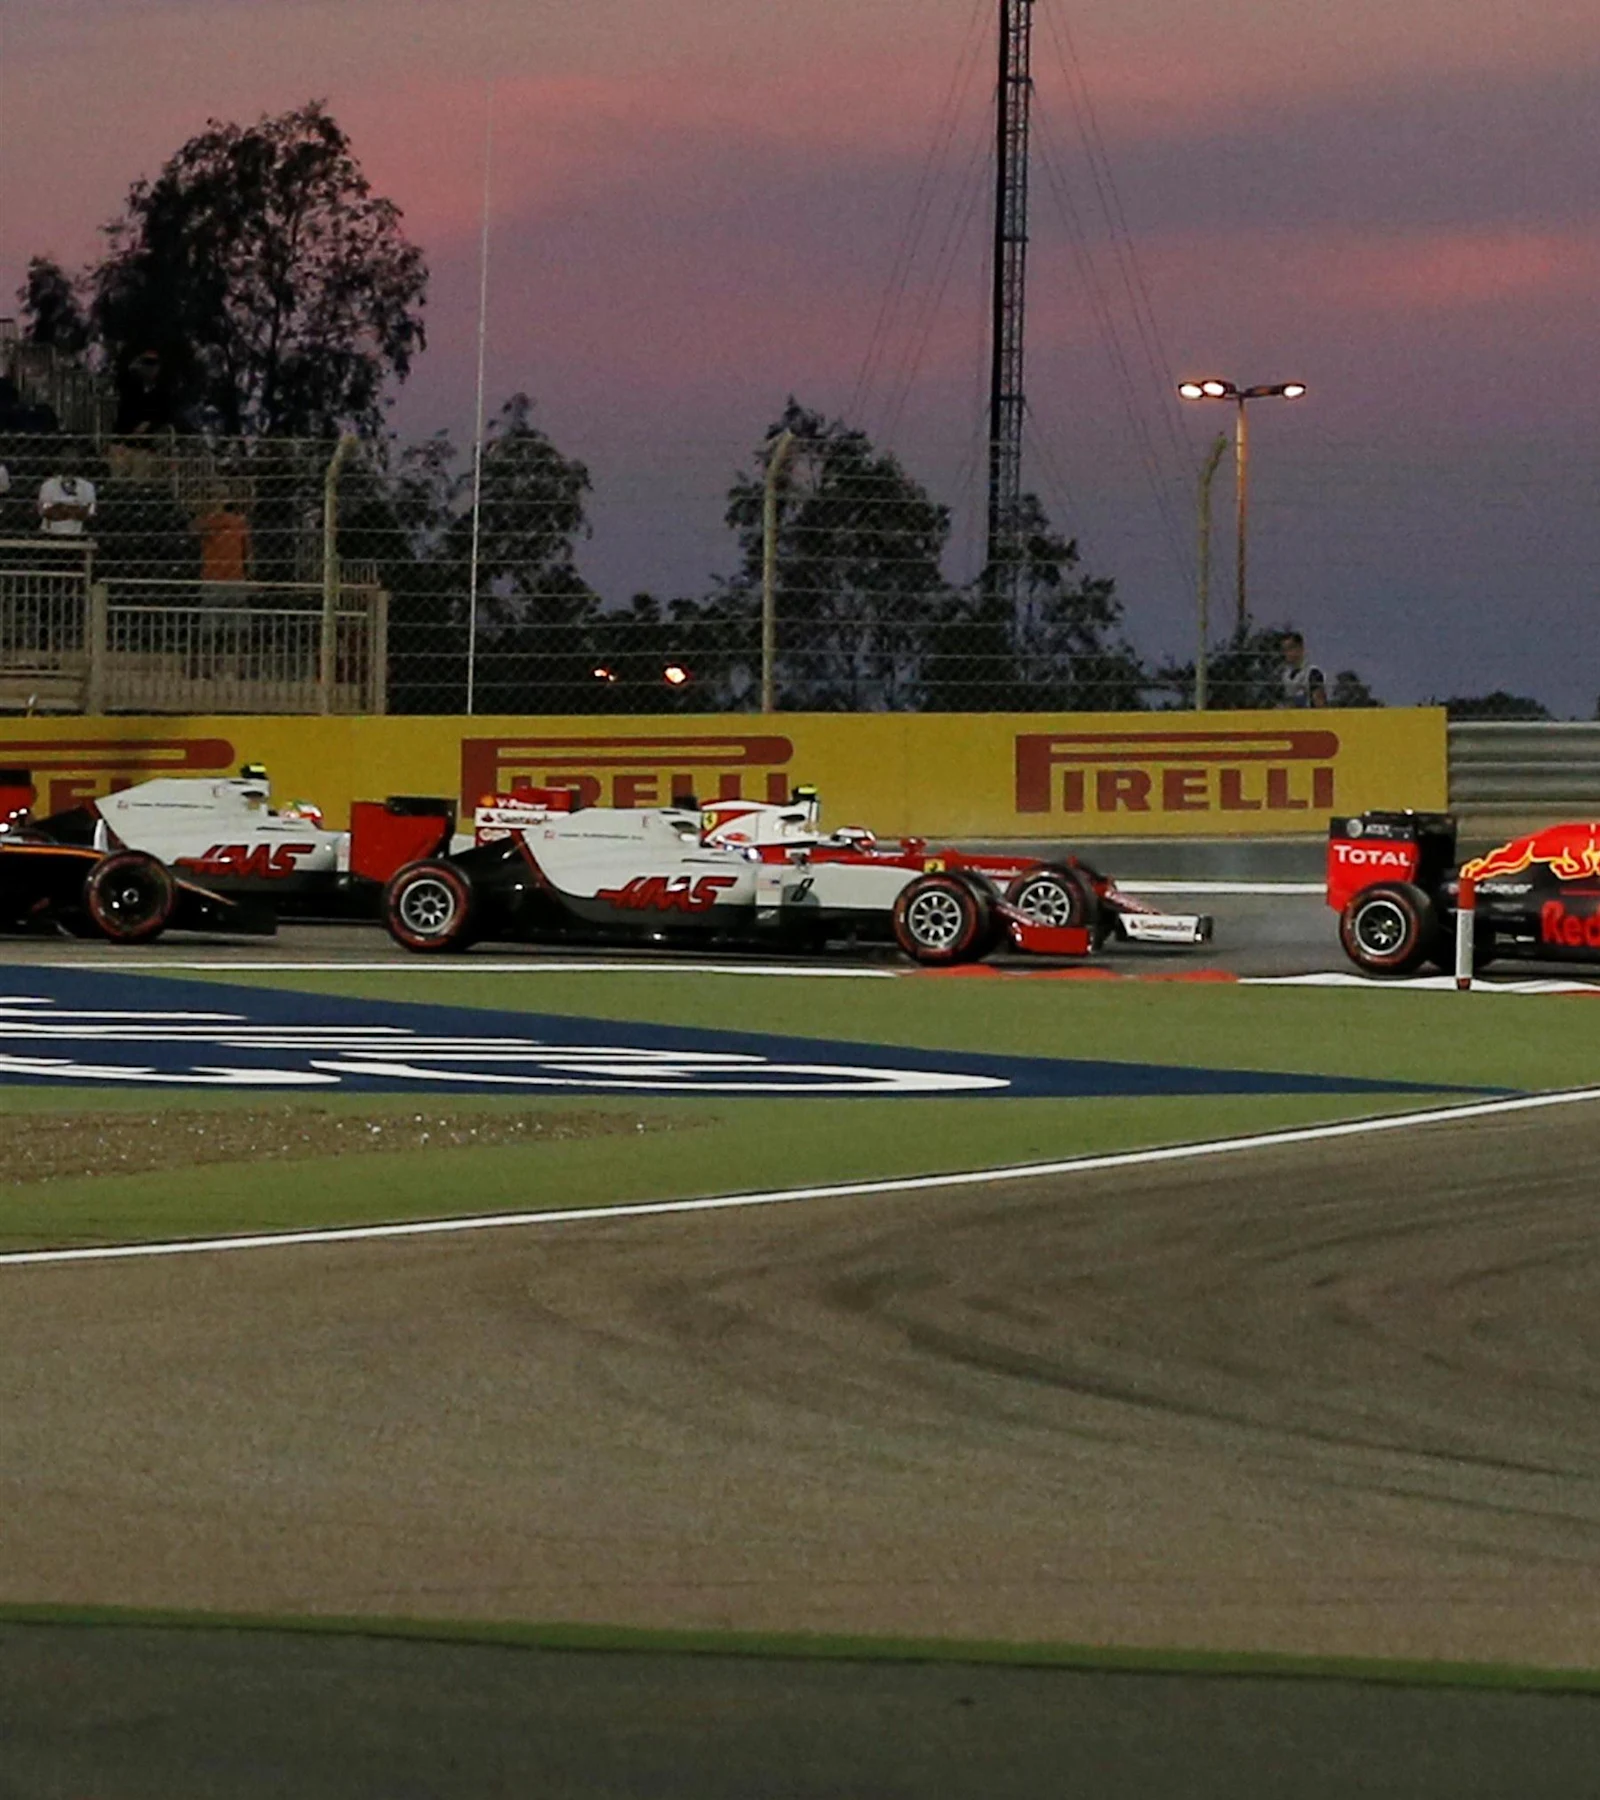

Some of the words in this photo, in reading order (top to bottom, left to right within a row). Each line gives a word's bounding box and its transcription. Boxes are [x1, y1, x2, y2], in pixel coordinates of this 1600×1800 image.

[1016, 731, 1339, 812] PIRELLI
[172, 843, 316, 880] HAAS
[1333, 844, 1412, 867] TOTAL
[594, 875, 739, 913] HAAS
